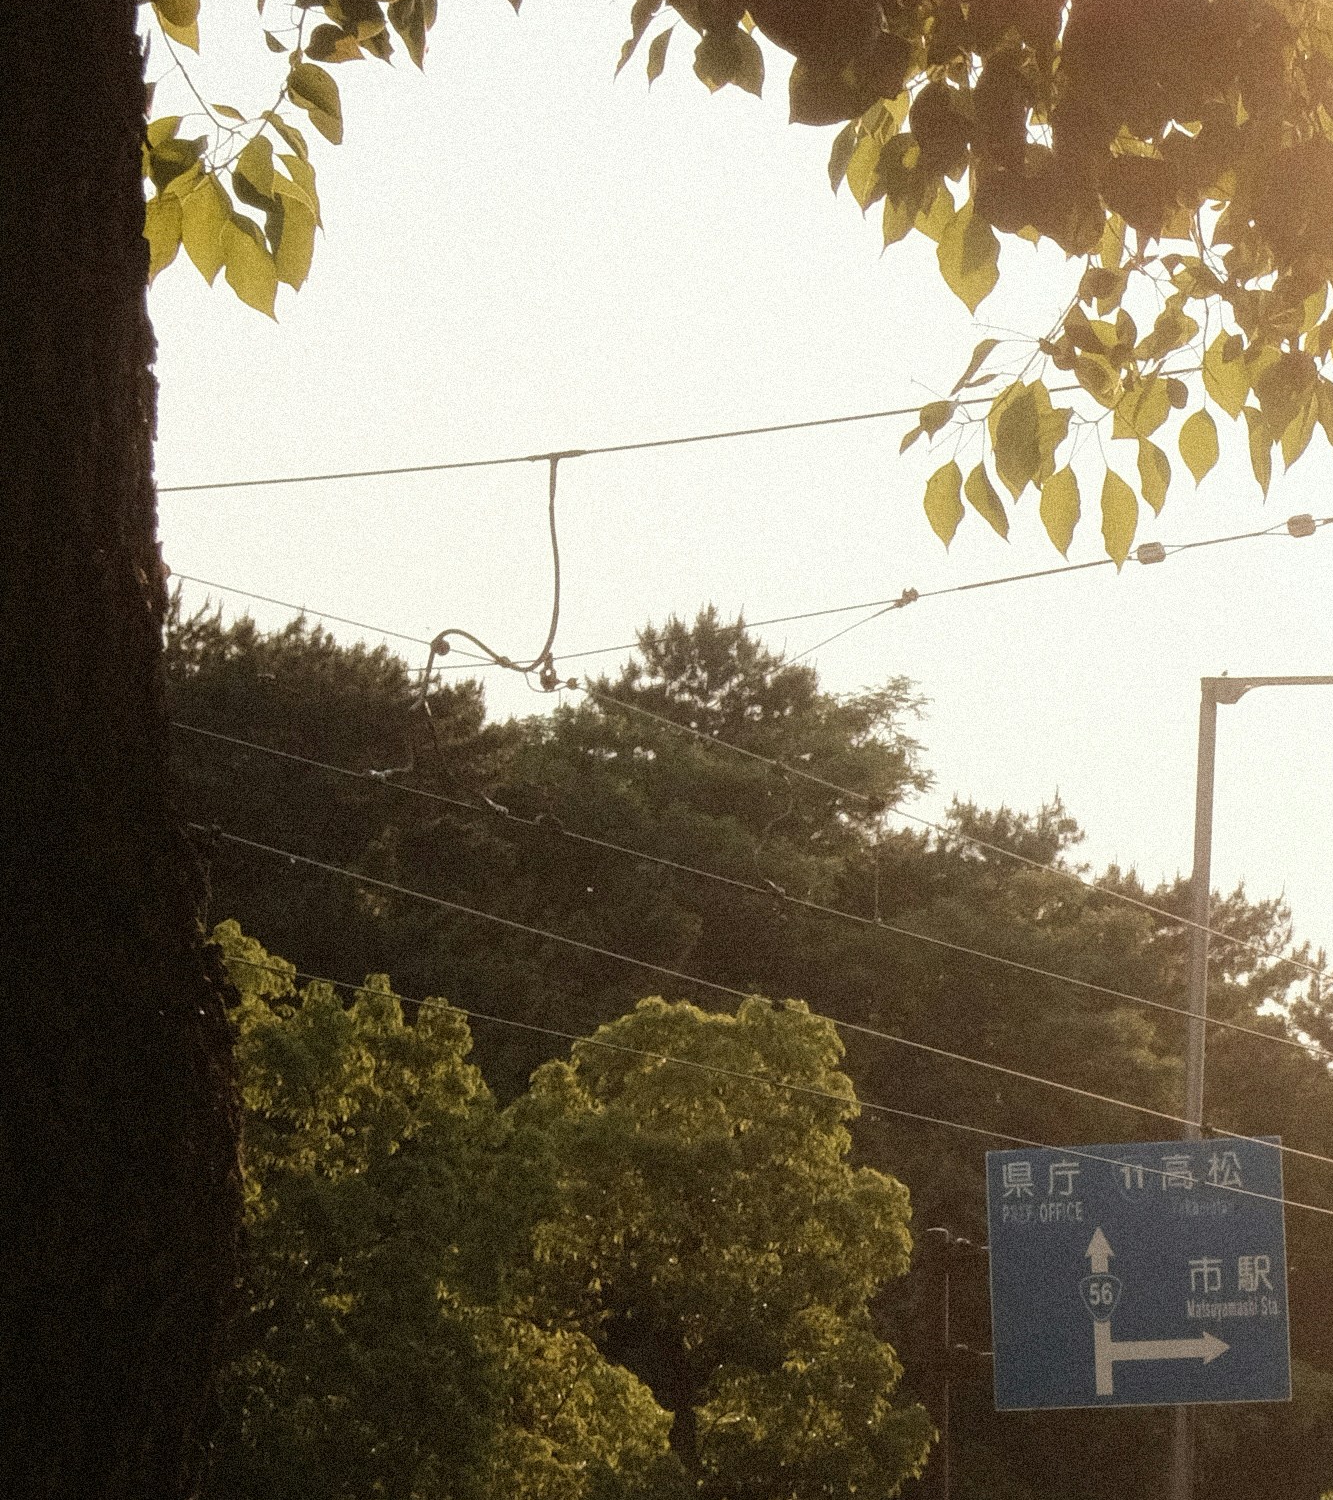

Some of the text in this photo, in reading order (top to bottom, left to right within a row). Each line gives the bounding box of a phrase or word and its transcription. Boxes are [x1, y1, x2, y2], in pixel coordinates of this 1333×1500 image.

[1002, 1160, 1082, 1198] 県庁
[1120, 1164, 1145, 1190] 11
[1161, 1151, 1243, 1191] 高松
[1039, 1201, 1083, 1222] OFFICE
[1187, 1254, 1274, 1294] 市駅
[1089, 1282, 1113, 1306] 56
